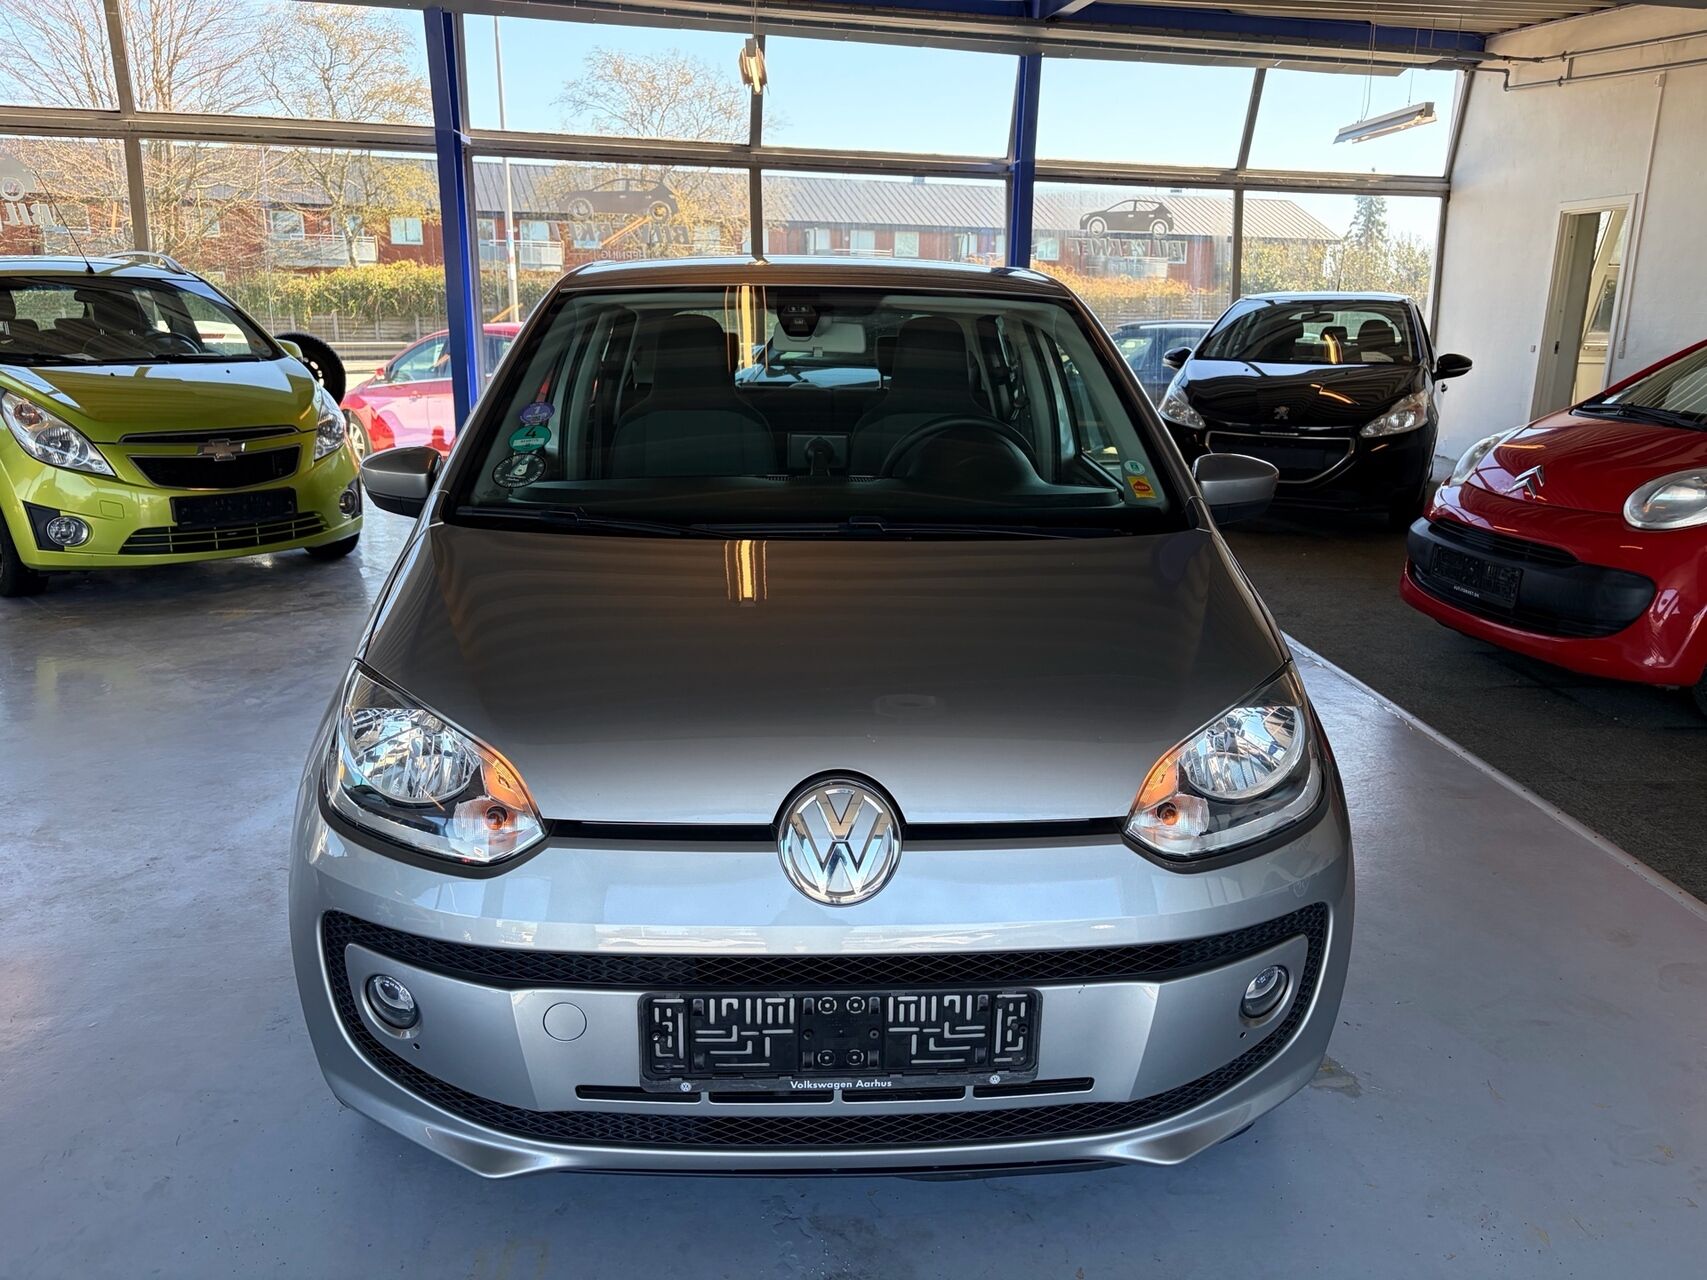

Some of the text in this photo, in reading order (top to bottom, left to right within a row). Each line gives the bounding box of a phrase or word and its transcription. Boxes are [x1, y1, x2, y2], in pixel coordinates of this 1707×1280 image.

[525, 427, 537, 438] 4
[790, 1079, 892, 1090] Volkswagen Aarhus
